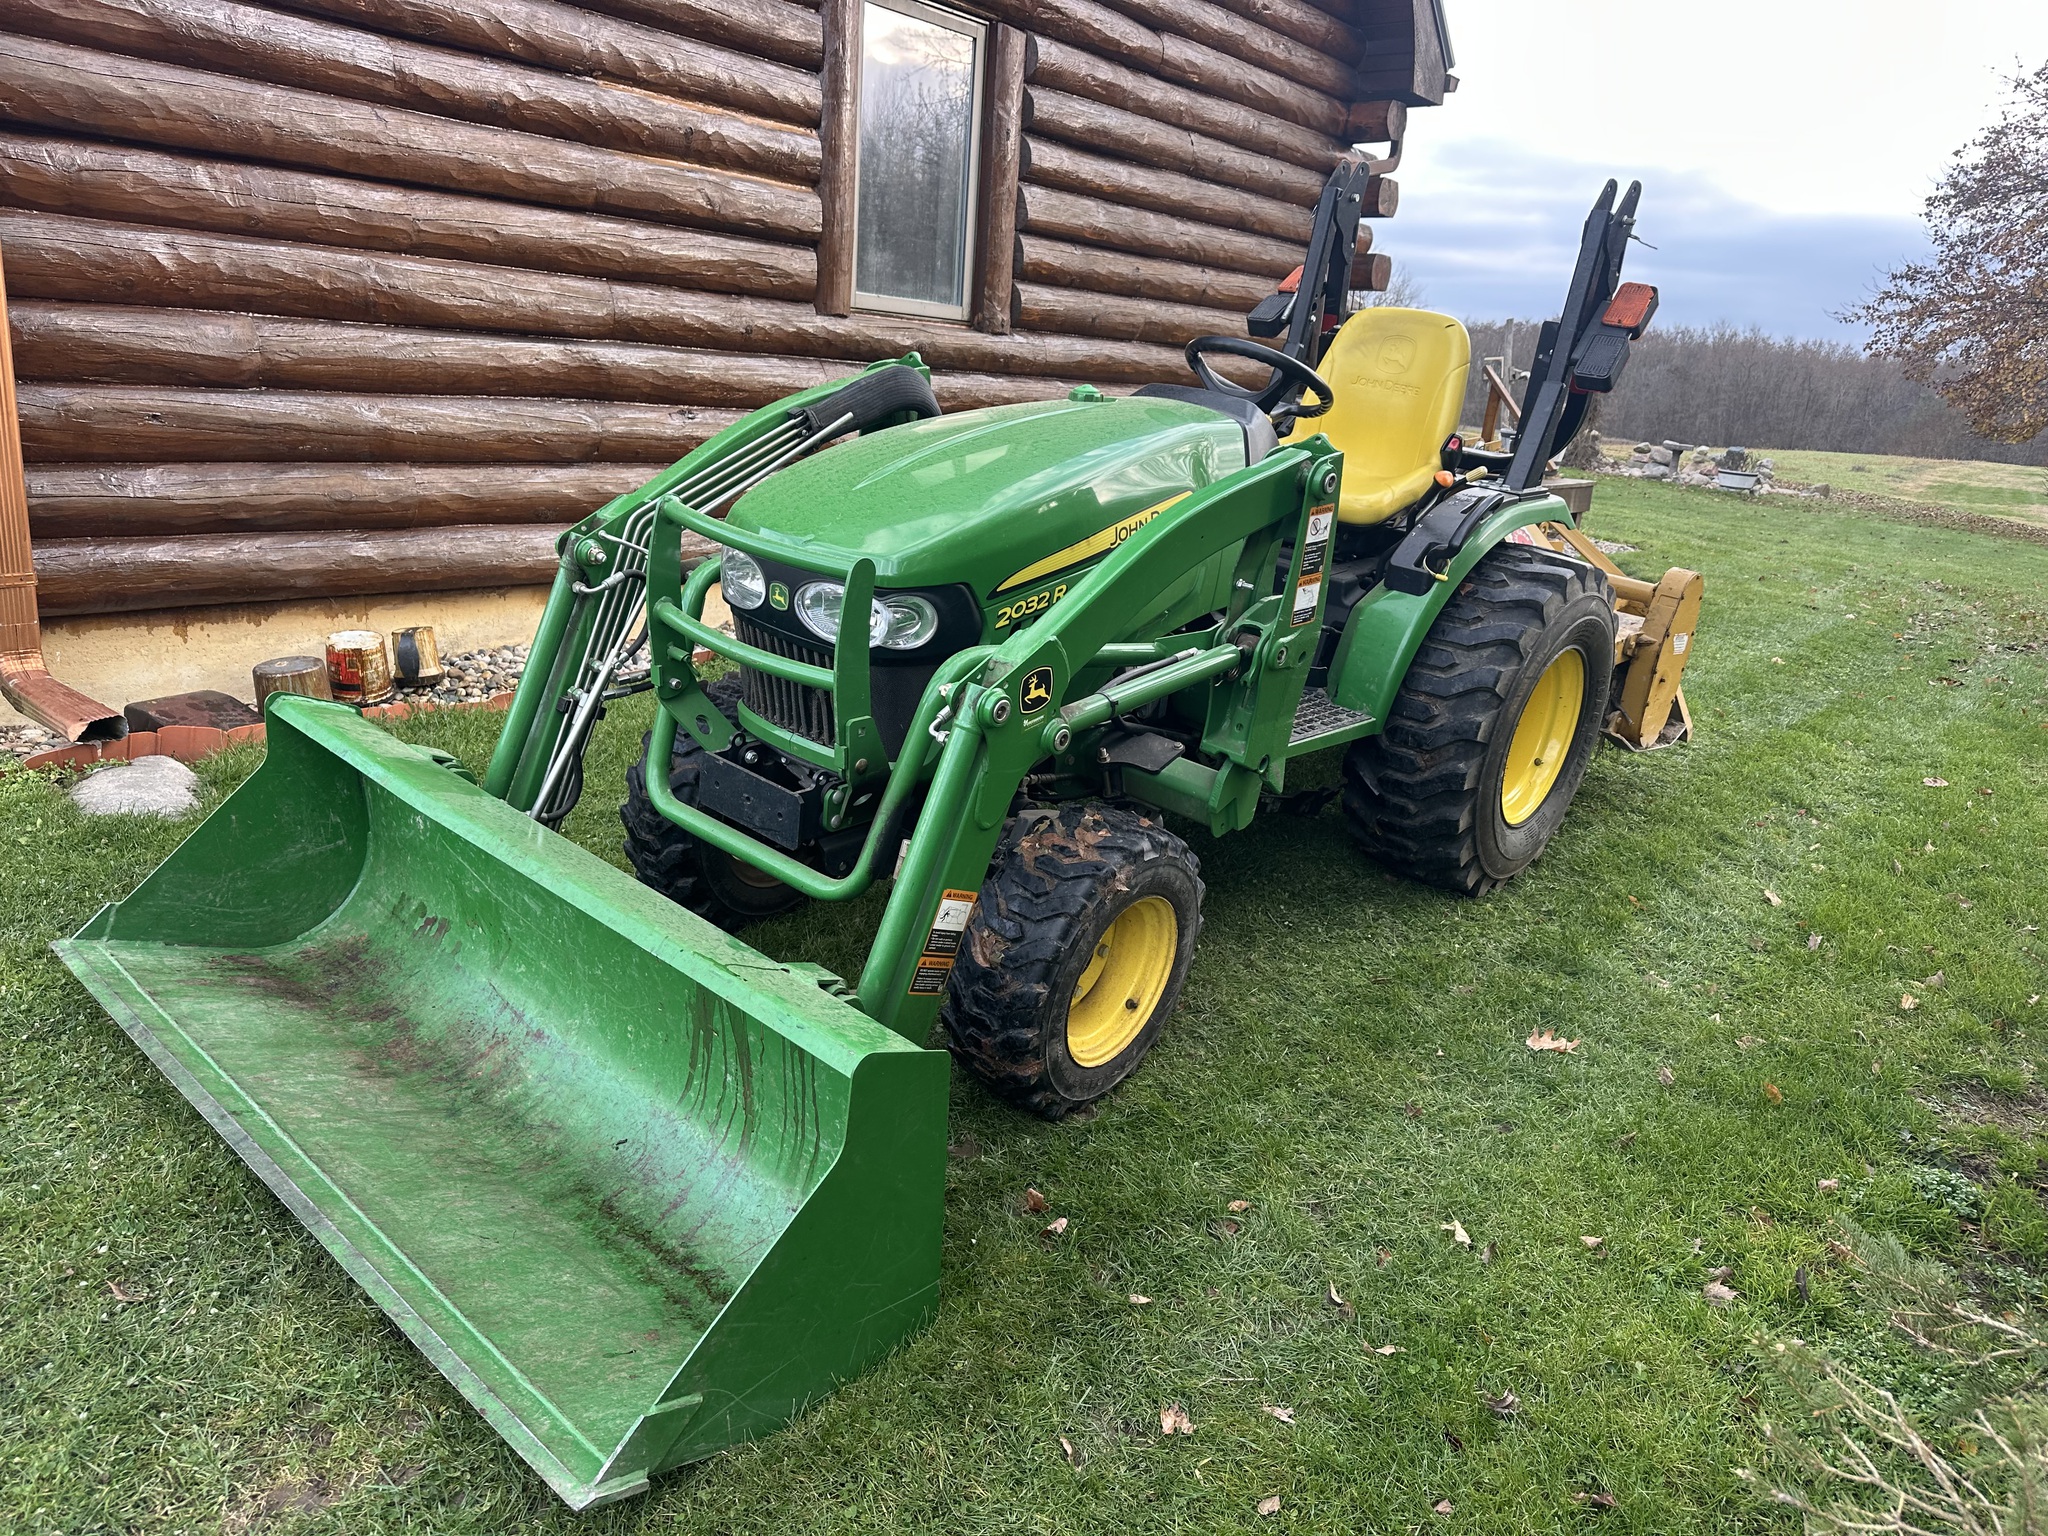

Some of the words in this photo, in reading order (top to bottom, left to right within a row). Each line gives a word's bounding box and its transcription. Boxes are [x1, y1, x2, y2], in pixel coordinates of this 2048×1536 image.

[1351, 375, 1383, 387] JOHN
[1384, 379, 1421, 396] DEERE
[994, 591, 1051, 630] 2032
[1052, 583, 1068, 604] R
[952, 892, 973, 900] WARNING
